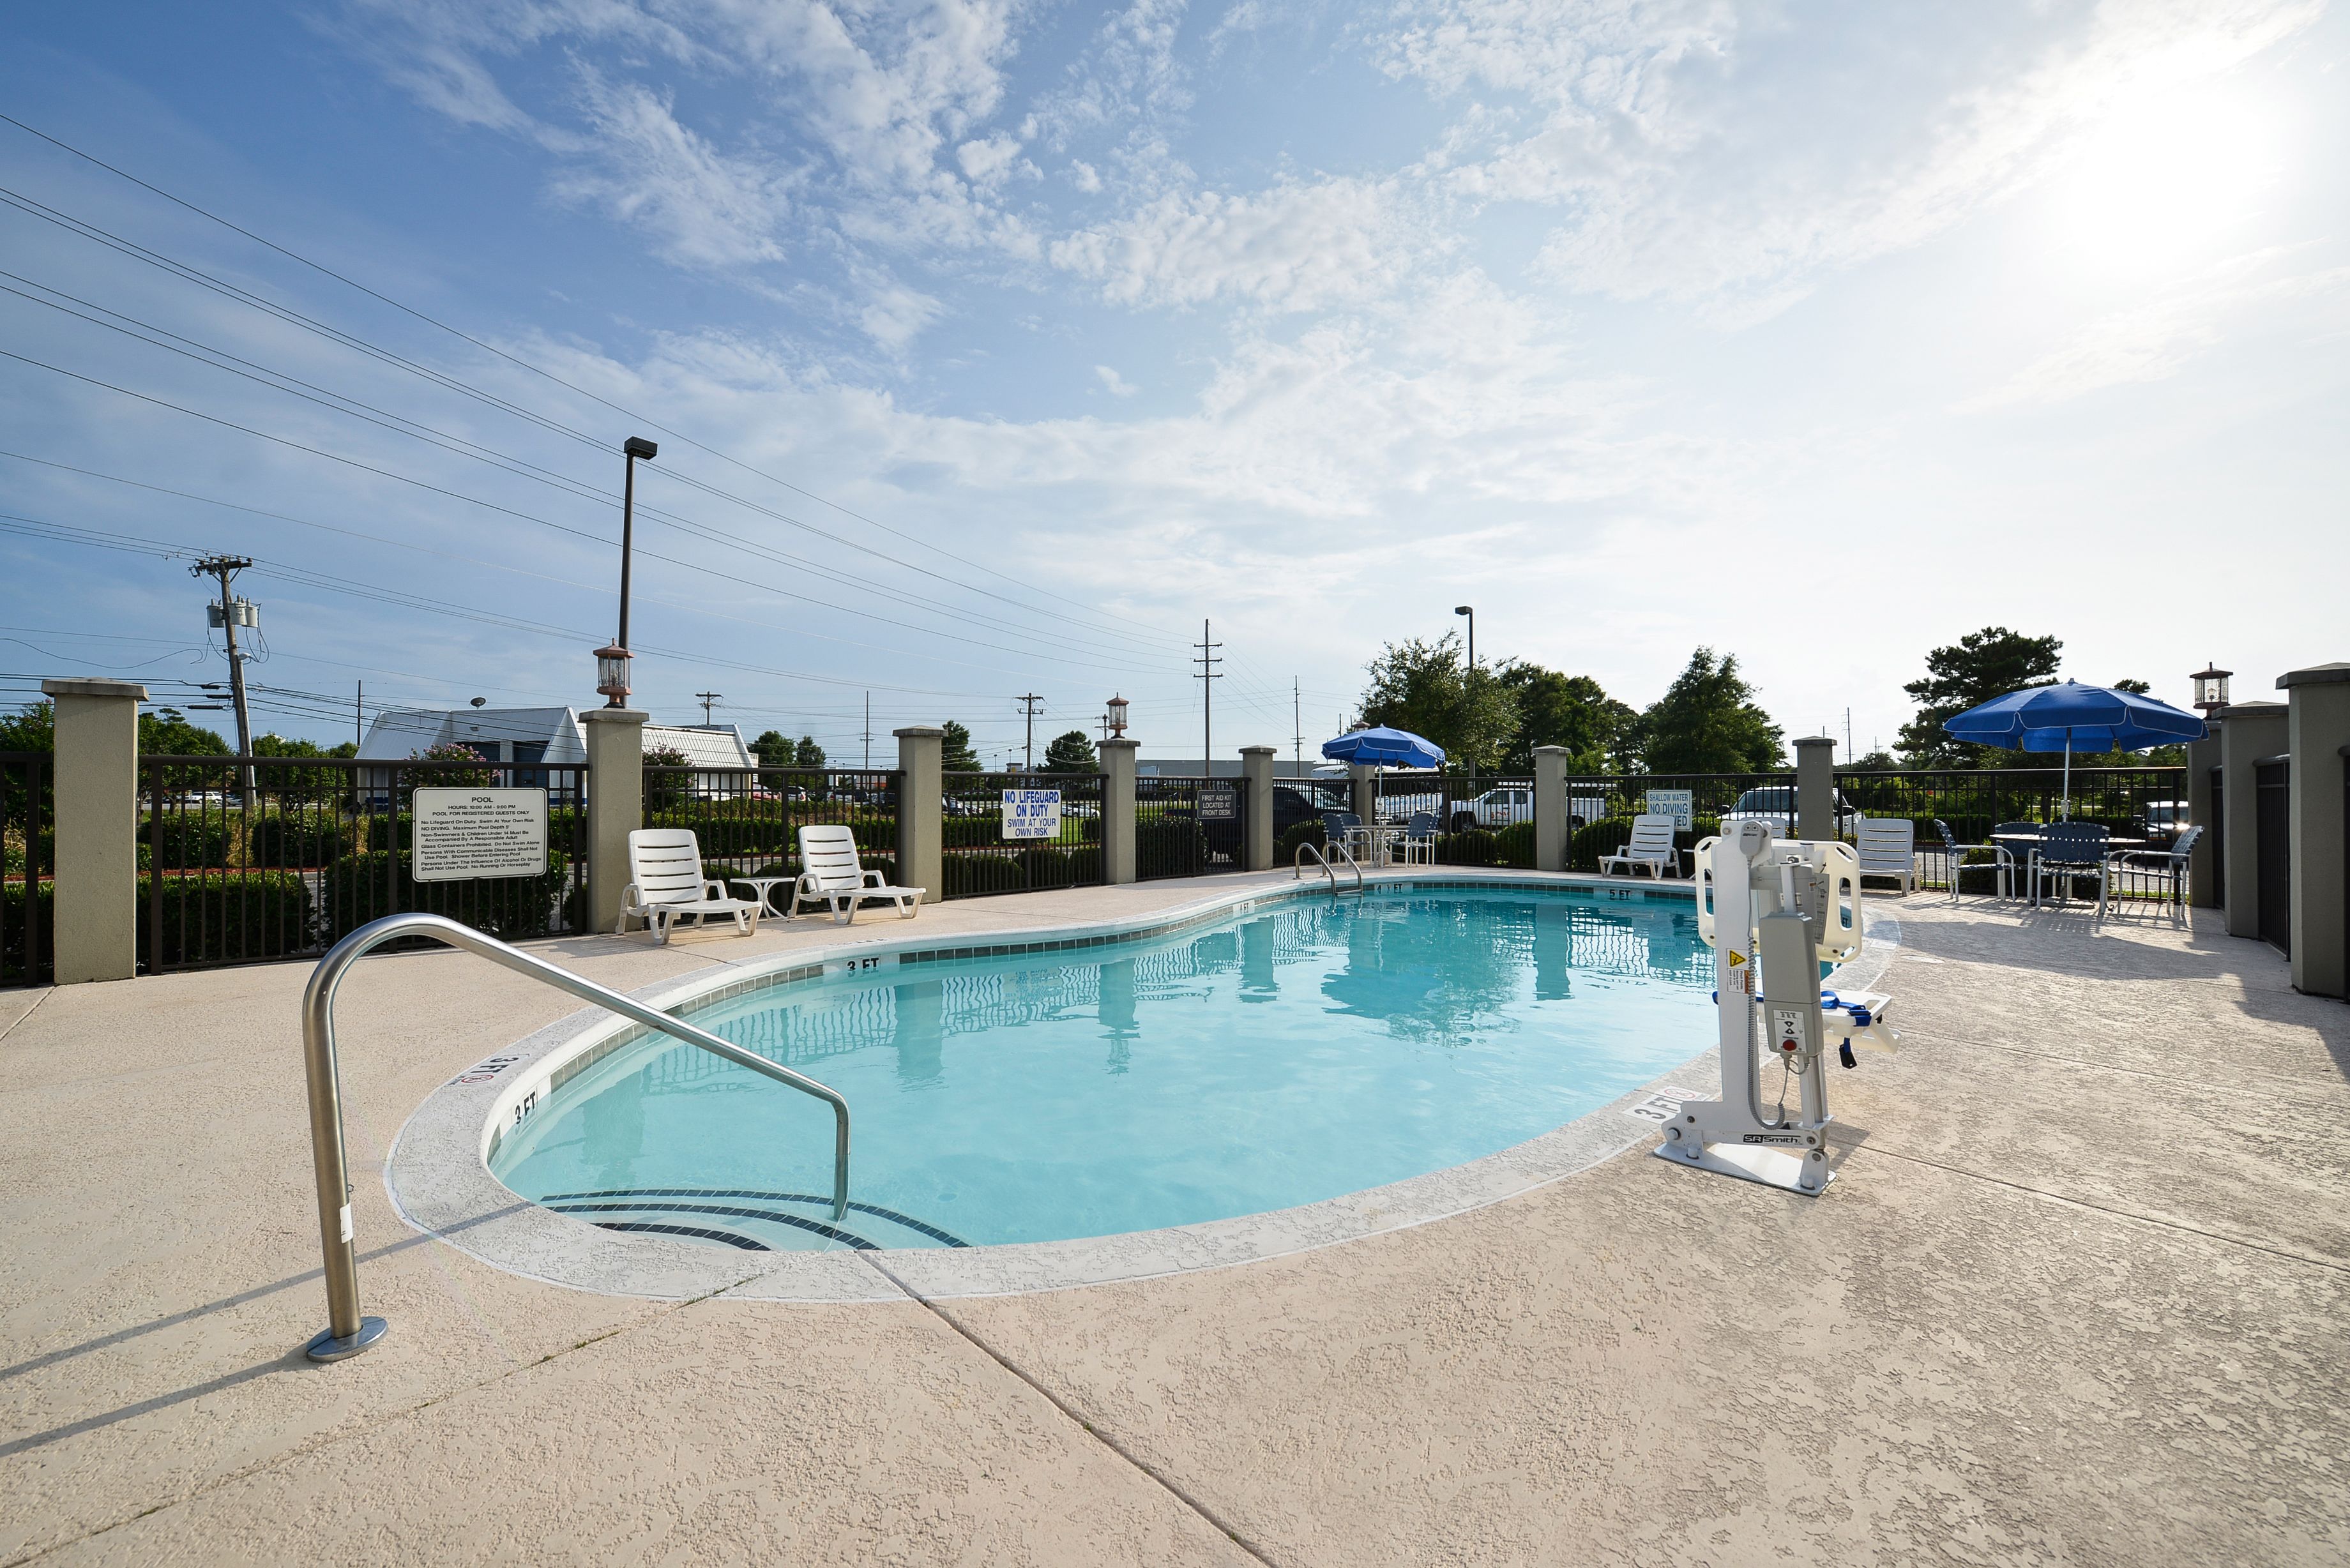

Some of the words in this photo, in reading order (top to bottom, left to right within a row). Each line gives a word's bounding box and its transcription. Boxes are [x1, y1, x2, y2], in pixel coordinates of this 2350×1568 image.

[1005, 791, 1015, 803] NO
[1019, 791, 1059, 803] LIFEGUARD
[1016, 804, 1026, 817] ON
[1031, 804, 1048, 817] DUTY
[1650, 803, 1660, 814] NO
[1663, 803, 1688, 814] DIVING
[1008, 818, 1025, 827] SWIM
[1028, 818, 1036, 827] AT
[1040, 818, 1056, 826] YOUR
[1015, 828, 1031, 836] OWN
[1035, 827, 1048, 836] RISK
[847, 961, 856, 970] 3
[862, 958, 879, 969] FT
[470, 1064, 509, 1073] FT
[515, 1104, 521, 1124] 3
[524, 1091, 536, 1116] FT
[1647, 1097, 1681, 1112] FT
[1634, 1109, 1667, 1119] 3
